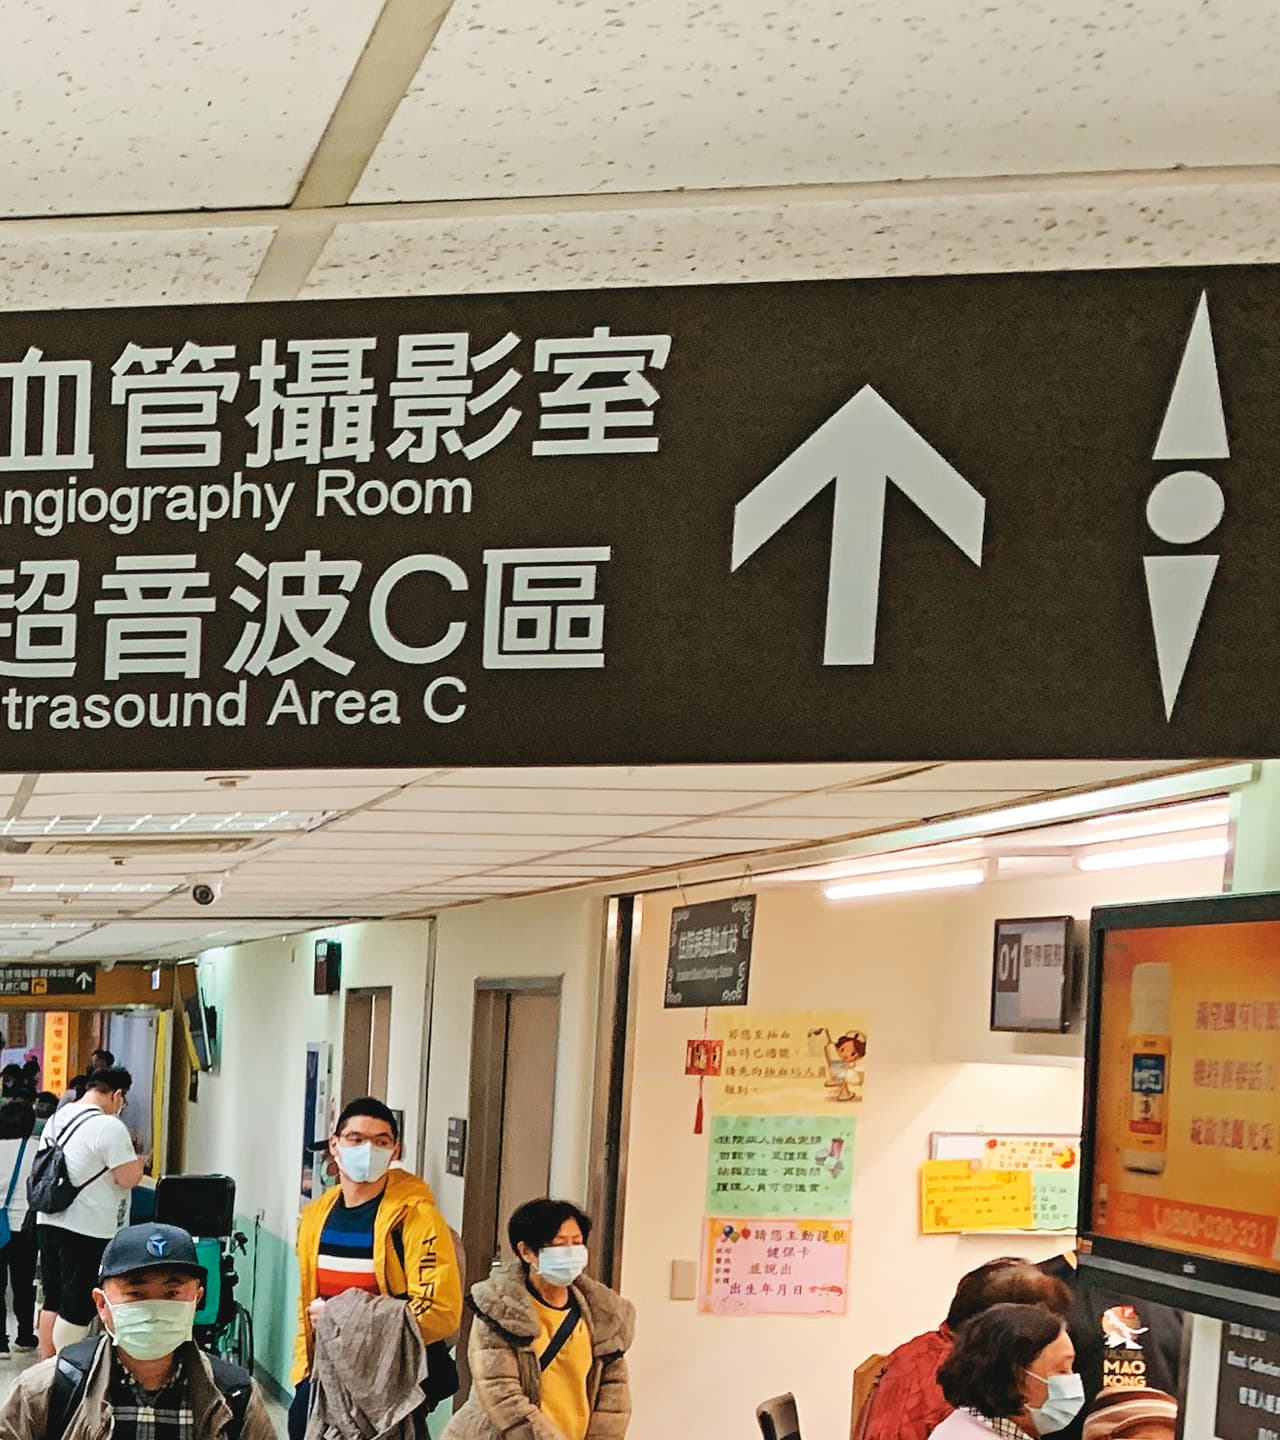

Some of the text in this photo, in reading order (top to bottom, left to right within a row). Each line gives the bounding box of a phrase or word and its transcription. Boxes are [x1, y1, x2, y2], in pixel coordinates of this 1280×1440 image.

[316, 470, 473, 518] Room
[266, 679, 402, 727] Area
[424, 677, 468, 724] C
[729, 1283, 803, 1296] 出生年月日
[1103, 1360, 1146, 1375] MAO
[1103, 1375, 1147, 1387] KONG
